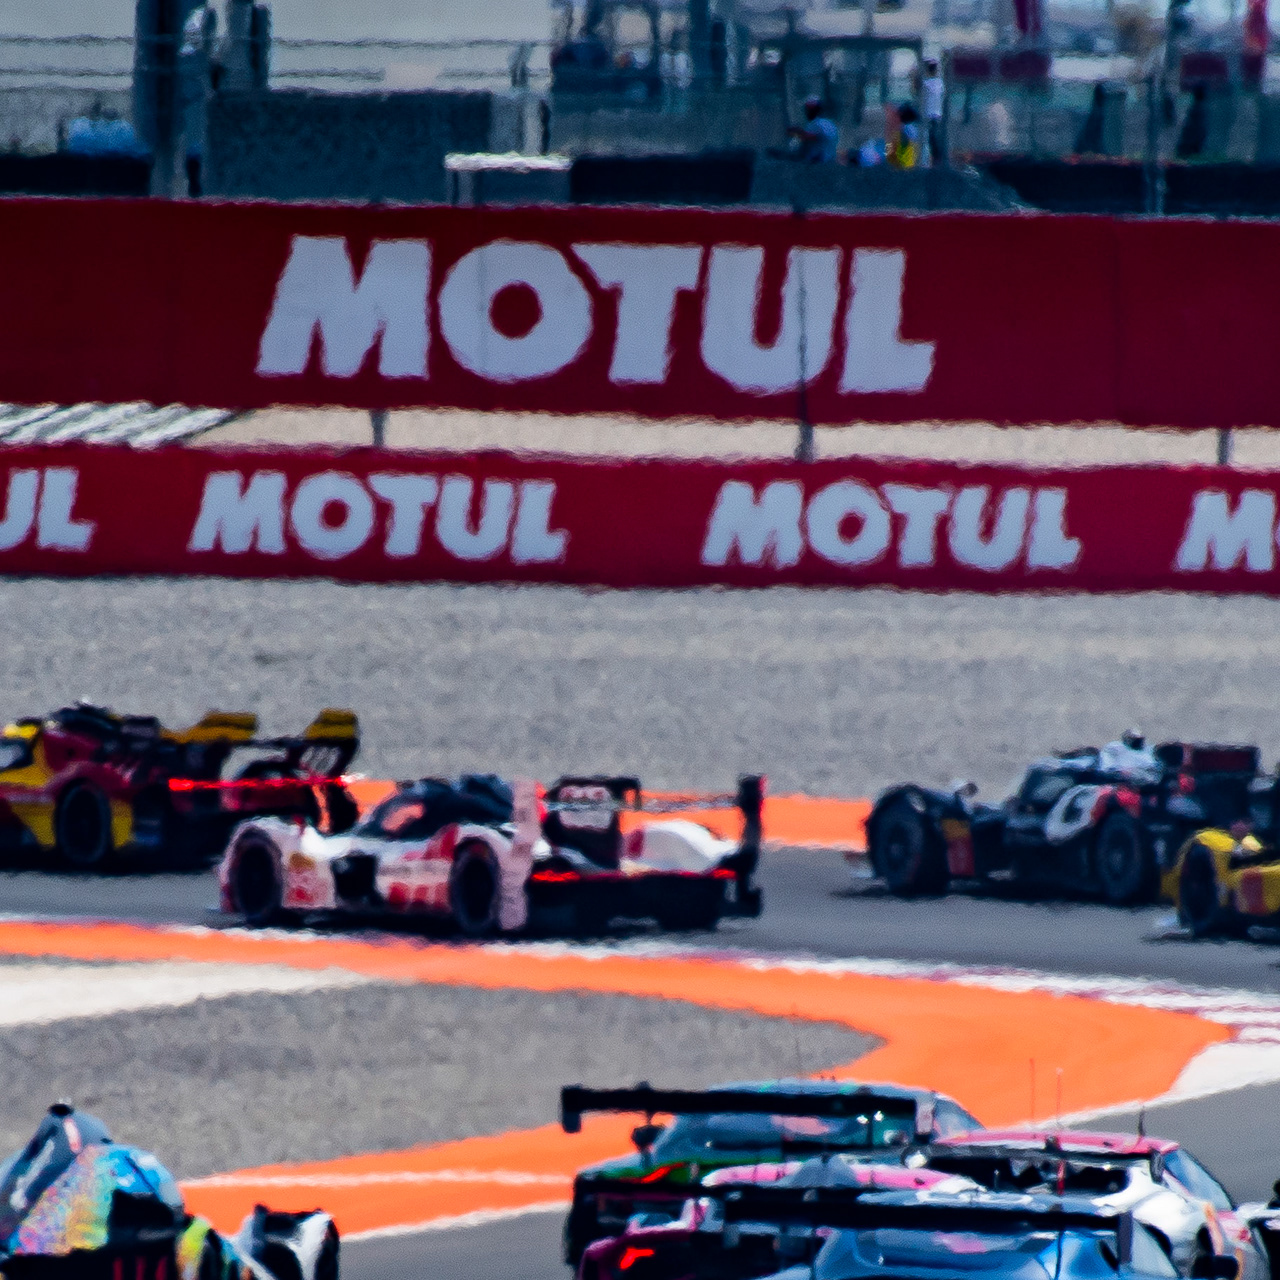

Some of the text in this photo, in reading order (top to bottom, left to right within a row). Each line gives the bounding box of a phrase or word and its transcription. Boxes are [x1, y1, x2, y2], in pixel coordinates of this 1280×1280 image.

[256, 235, 935, 394] MOTUL
[190, 470, 566, 562] MOTUL
[702, 479, 1082, 570] MOTUL
